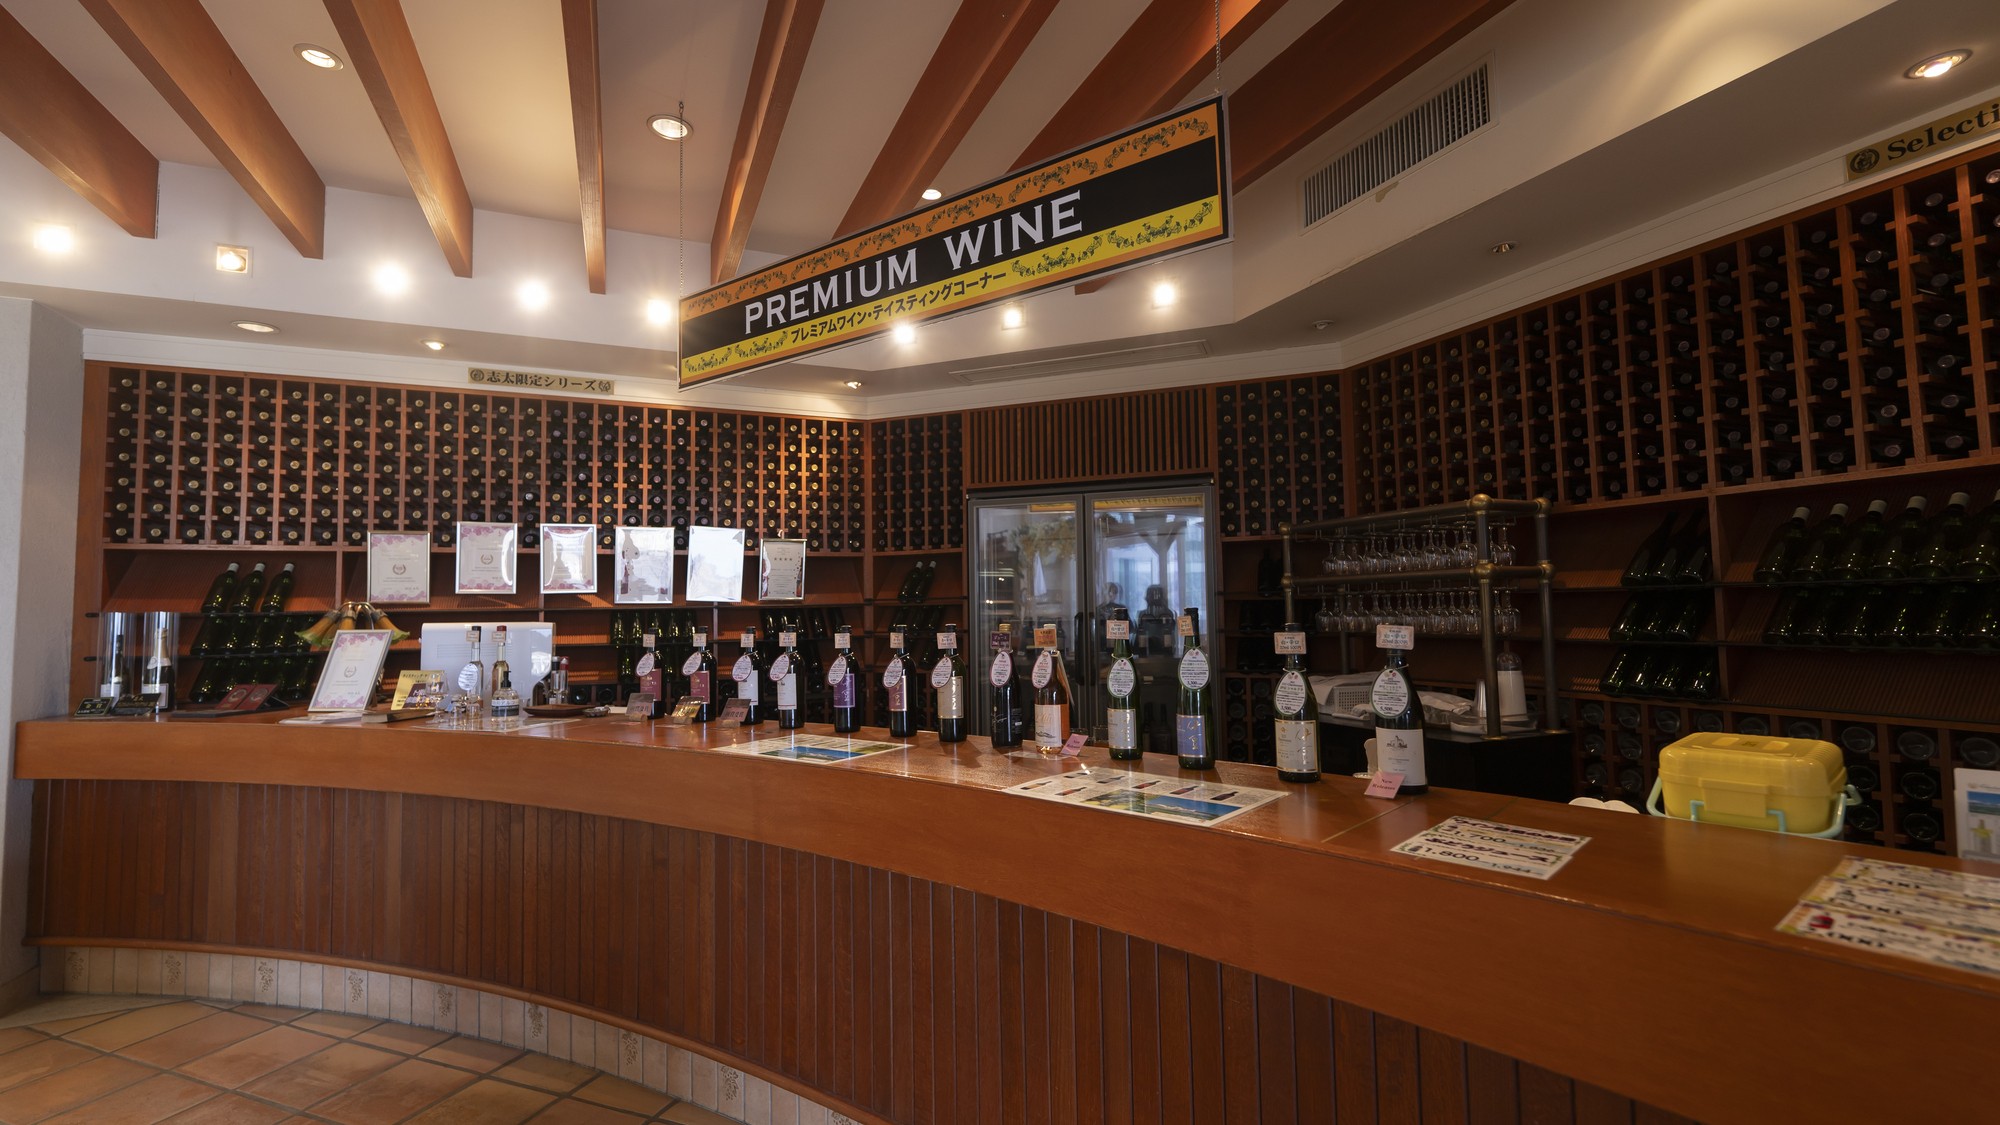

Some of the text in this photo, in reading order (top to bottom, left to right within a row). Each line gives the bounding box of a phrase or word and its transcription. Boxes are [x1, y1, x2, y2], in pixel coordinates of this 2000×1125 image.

[744, 189, 1085, 335] PREMIUM WINE
[790, 270, 1007, 344] プレミアムワイン・テイスティングコーナー
[486, 371, 597, 391] 志太限定シリーズ
